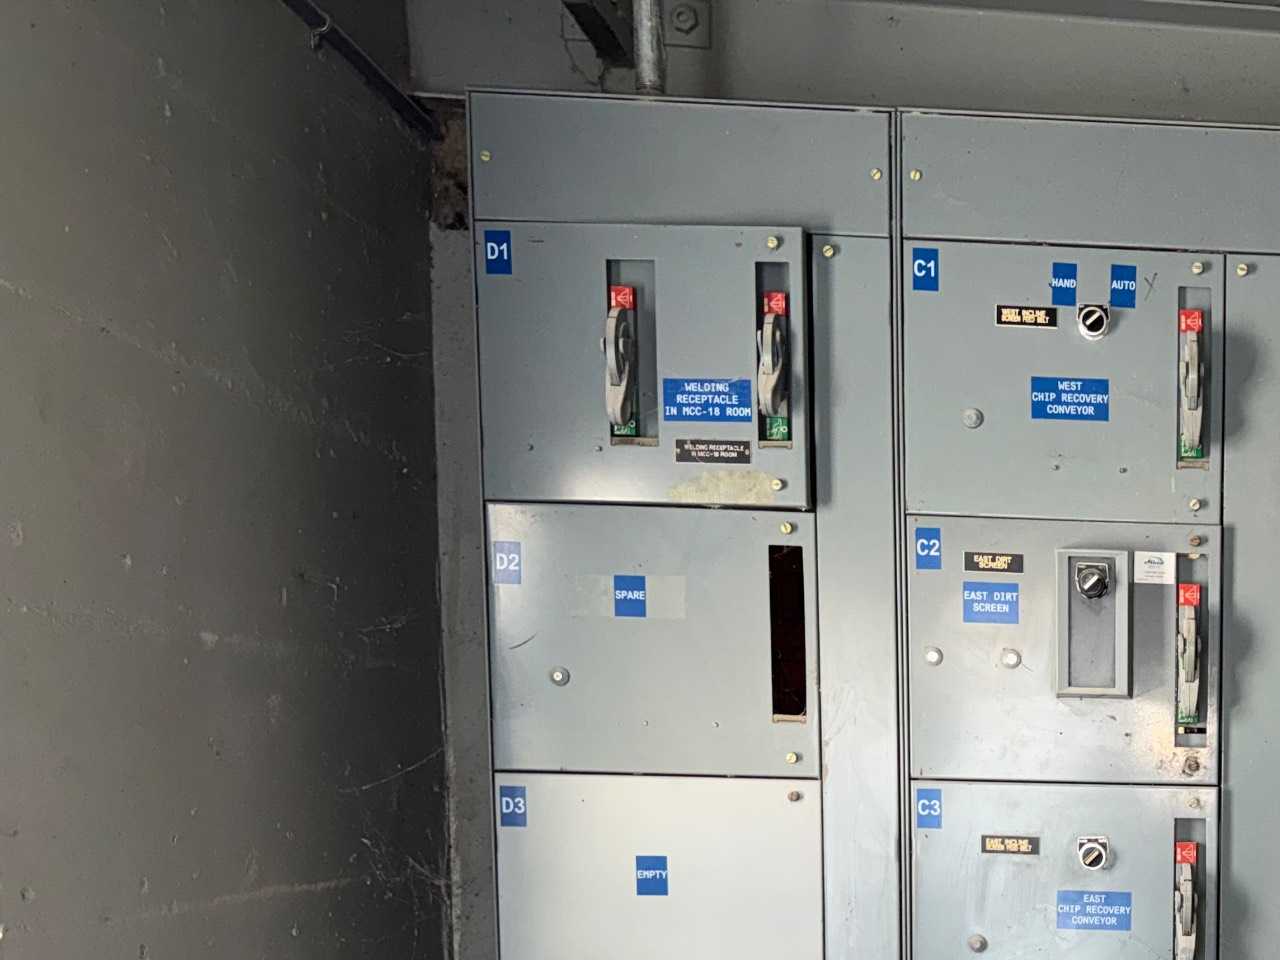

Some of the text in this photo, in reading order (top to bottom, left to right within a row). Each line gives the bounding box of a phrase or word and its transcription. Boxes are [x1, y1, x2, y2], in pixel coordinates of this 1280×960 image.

[487, 243, 509, 260] D1
[914, 260, 936, 277] C1
[1052, 278, 1077, 288] HAND
[1111, 280, 1136, 290] AUTO
[685, 383, 729, 392] WELDING
[1058, 382, 1082, 391] WEST
[677, 395, 738, 404] RECEPTACLE
[1032, 392, 1109, 403] CHIP RECOVERY
[665, 406, 751, 416] IN MCC-18 ROOM
[1047, 405, 1095, 415] CONVEYOR
[917, 539, 940, 556] C2
[496, 553, 519, 570] D2
[616, 590, 645, 600] SPARE
[965, 591, 1018, 601] EAST DIRT
[973, 603, 1009, 612] SCREEN
[502, 797, 525, 813] D3
[918, 800, 940, 815] C3
[637, 870, 667, 879] EMPTY
[1084, 894, 1105, 903] EAST
[1058, 905, 1130, 915] CHIP RECOVERY
[1072, 916, 1117, 925] CONVEYOR
